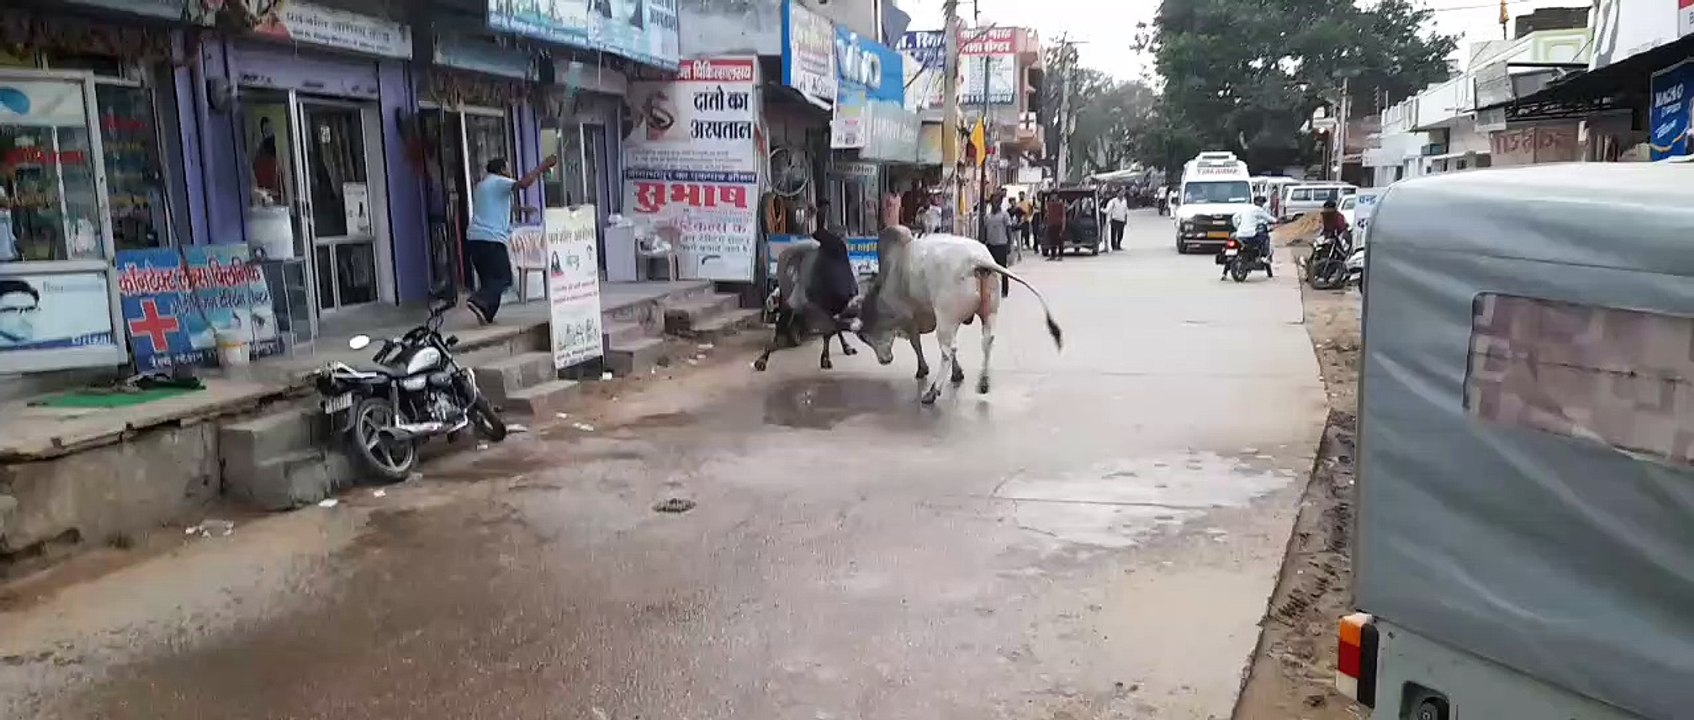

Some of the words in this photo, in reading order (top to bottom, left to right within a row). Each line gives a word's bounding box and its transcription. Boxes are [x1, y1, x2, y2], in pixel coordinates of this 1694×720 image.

[836, 32, 882, 90] vivo
[727, 91, 749, 111] का
[690, 120, 751, 139] अस्पताल
[633, 182, 747, 213] सुभाष
